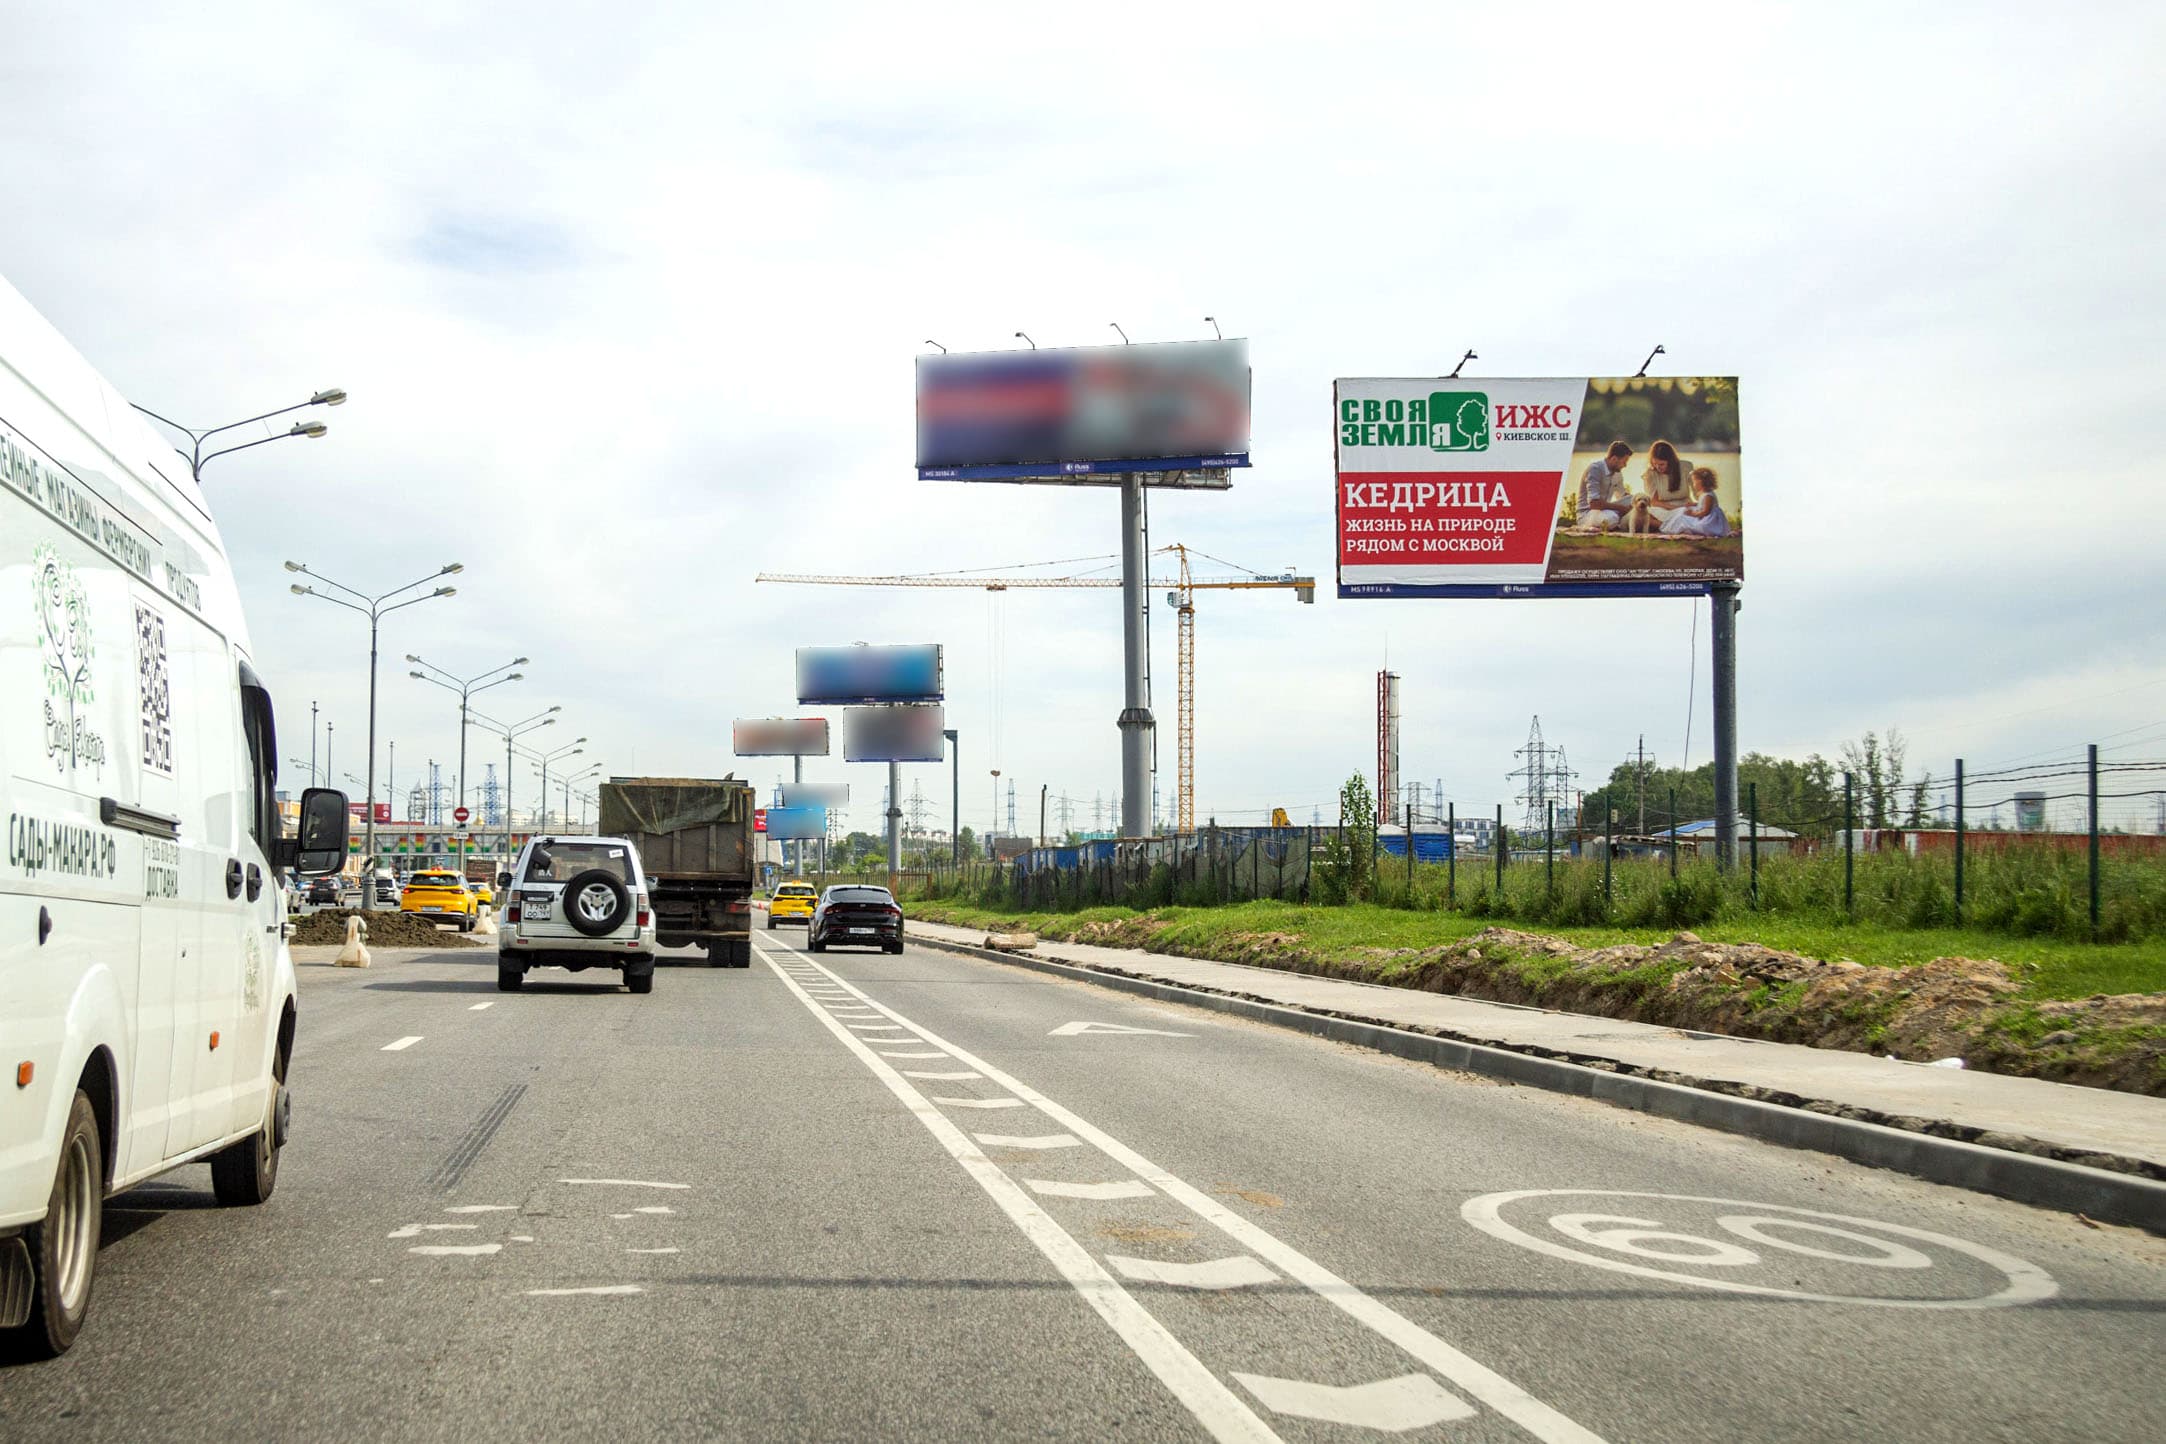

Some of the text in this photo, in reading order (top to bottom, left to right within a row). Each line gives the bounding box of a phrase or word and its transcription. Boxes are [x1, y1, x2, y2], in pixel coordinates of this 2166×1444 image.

[1341, 399, 1427, 423] СВОЯ
[1495, 404, 1572, 429] ИЖС
[1341, 423, 1451, 447] ЗЕМЛЯ
[1503, 432, 1572, 441] КИЕВСКОЕ Ш.
[0, 432, 42, 503] ЕЙНЫЕ
[1345, 482, 1511, 513] КЕДРИЦА
[1346, 518, 1516, 534] ЖИЗНЬ НА ПРИРОДЕ
[1346, 535, 1505, 554] РЯДОМ С МОСКВОЙ
[9, 812, 116, 880] САДЫ-МАКАРА.РФ
[1549, 1213, 1932, 1269] 60
